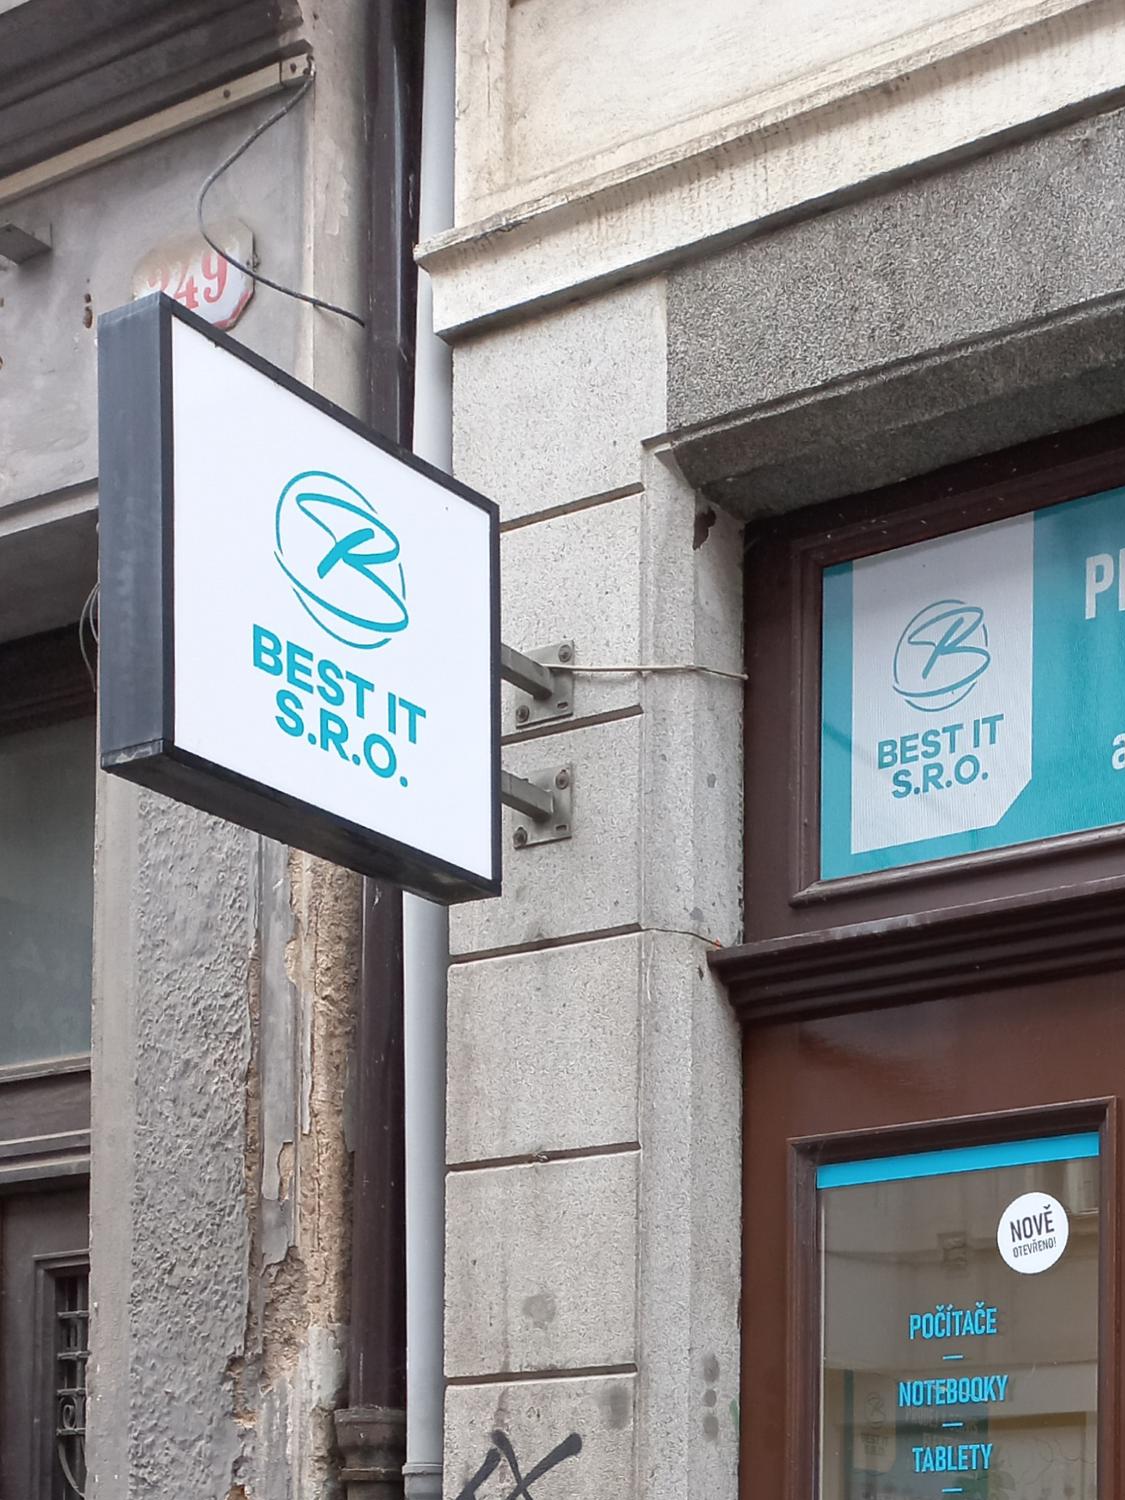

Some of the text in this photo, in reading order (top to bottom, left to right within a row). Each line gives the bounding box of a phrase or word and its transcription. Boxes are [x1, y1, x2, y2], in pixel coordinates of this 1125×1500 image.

[253, 624, 426, 744] BEST IT
[275, 689, 408, 787] S.R.O.
[877, 714, 1004, 771] BEST IT
[891, 755, 988, 799] S.R.O.
[1010, 1205, 1055, 1243] NOVĚ
[1013, 1237, 1057, 1258] OTEVŘENO!
[910, 1301, 997, 1340] POČÍTAČE
[899, 1375, 1008, 1407] NOTEBOOKY
[912, 1443, 993, 1473] TABLETY
